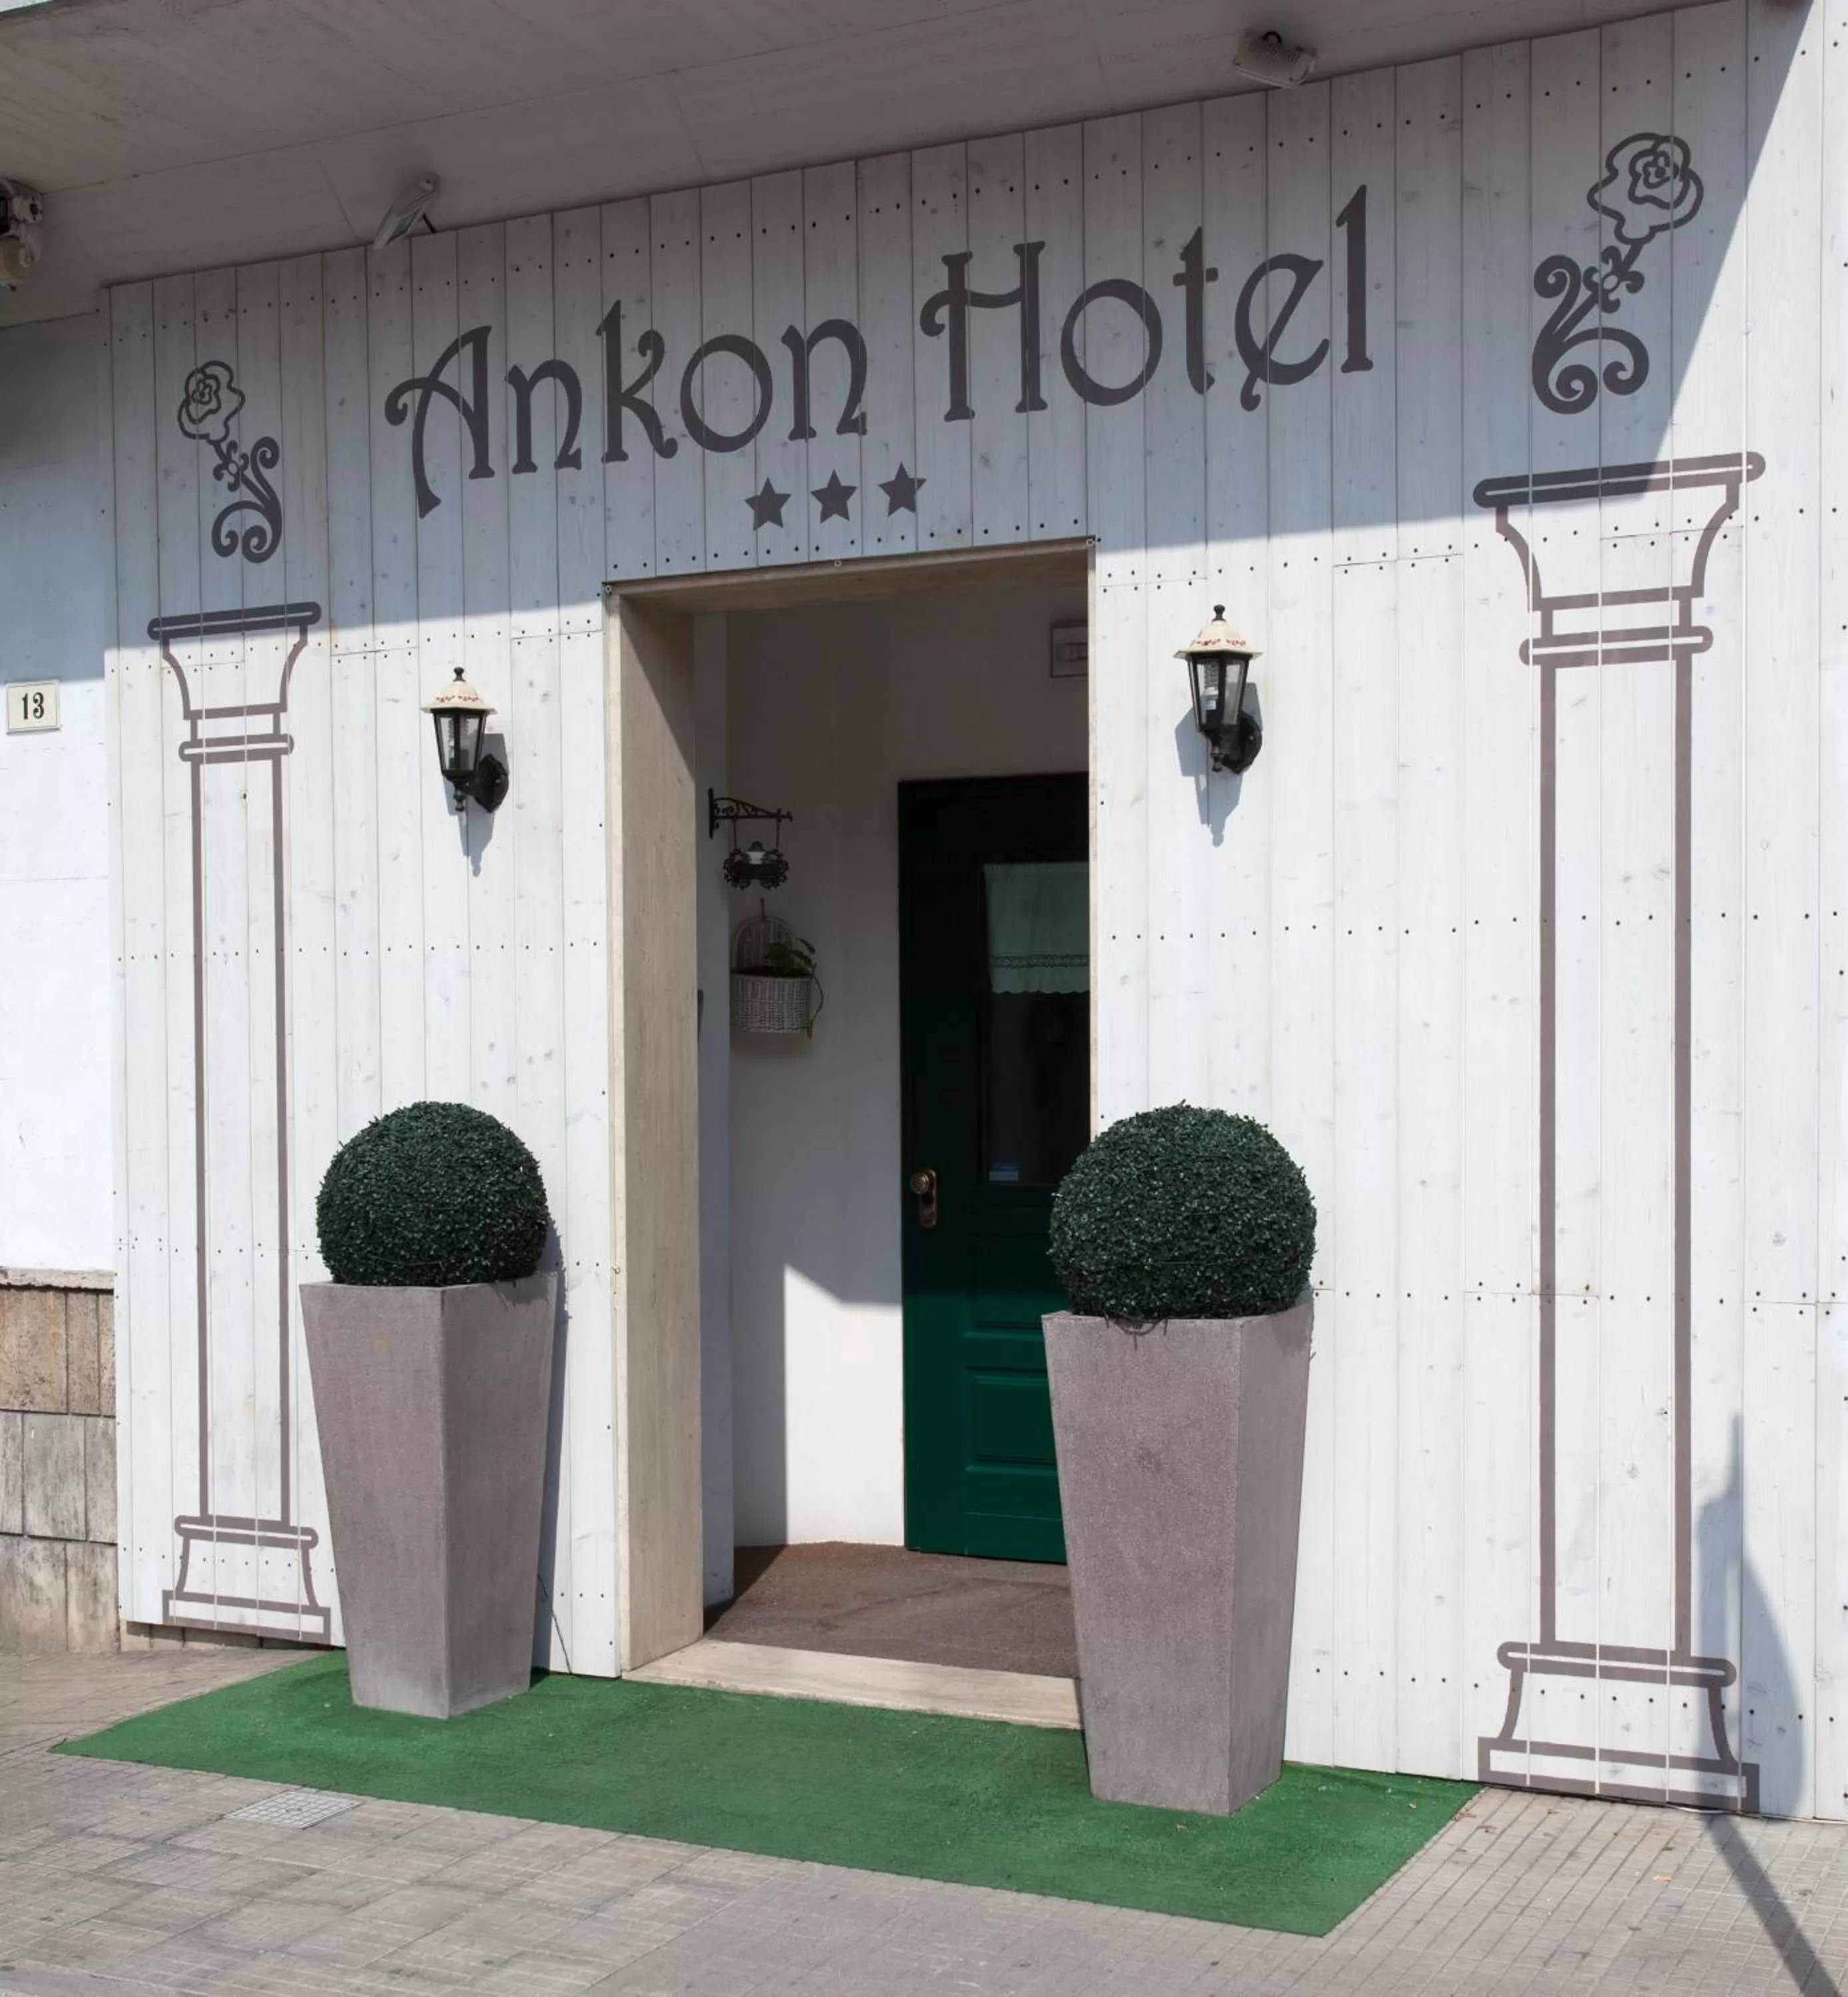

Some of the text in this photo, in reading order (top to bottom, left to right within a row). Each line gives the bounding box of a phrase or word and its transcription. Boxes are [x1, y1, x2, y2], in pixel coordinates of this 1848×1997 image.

[385, 184, 1373, 518] Ankon Hotel
[22, 692, 45, 720] 13
